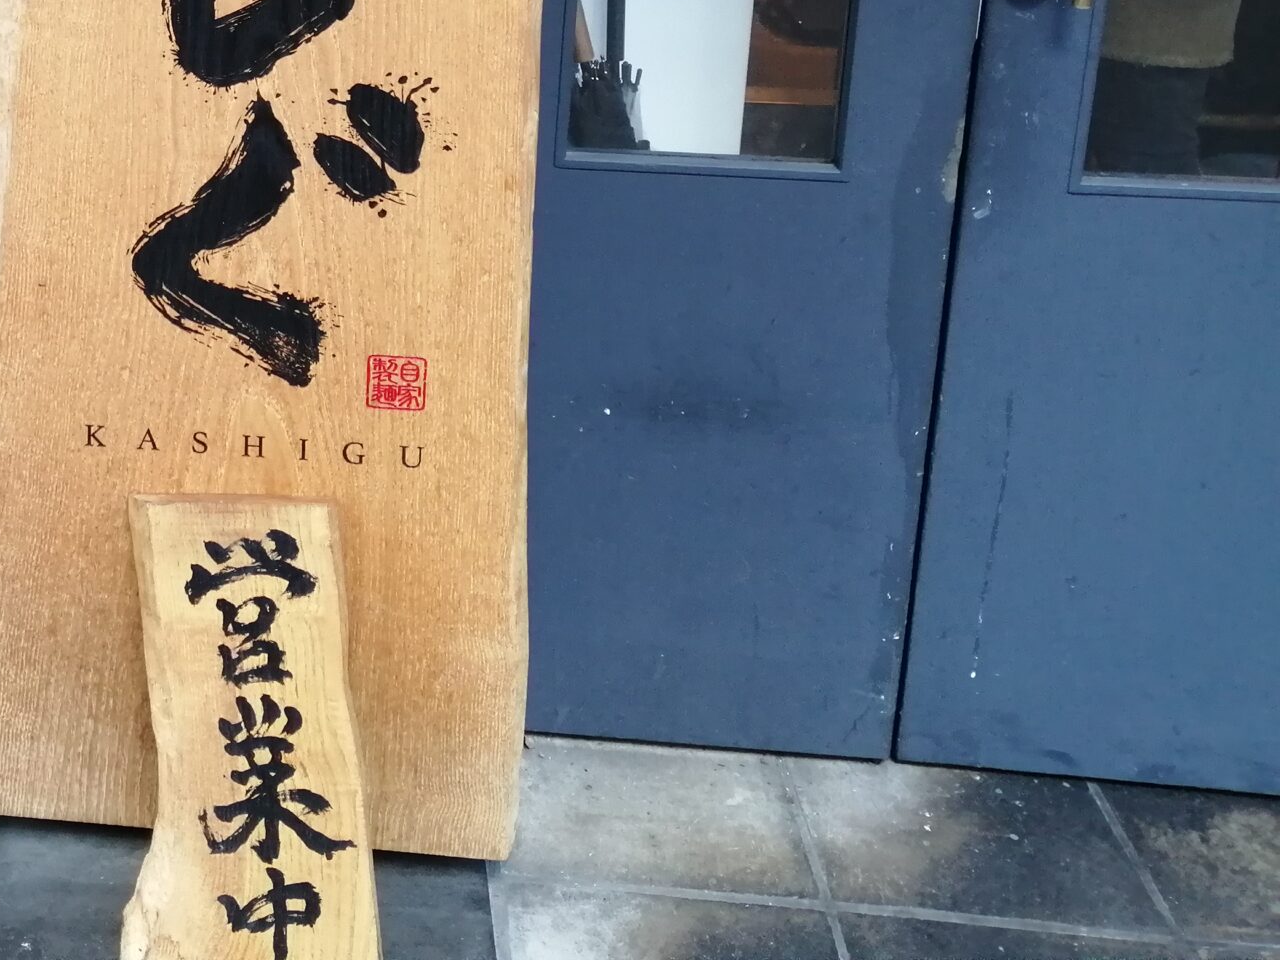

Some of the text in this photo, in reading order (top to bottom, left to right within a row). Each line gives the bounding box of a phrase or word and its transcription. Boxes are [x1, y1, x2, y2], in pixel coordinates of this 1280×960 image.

[84, 423, 426, 470] KASHIGU
[183, 528, 357, 959] 営業中
